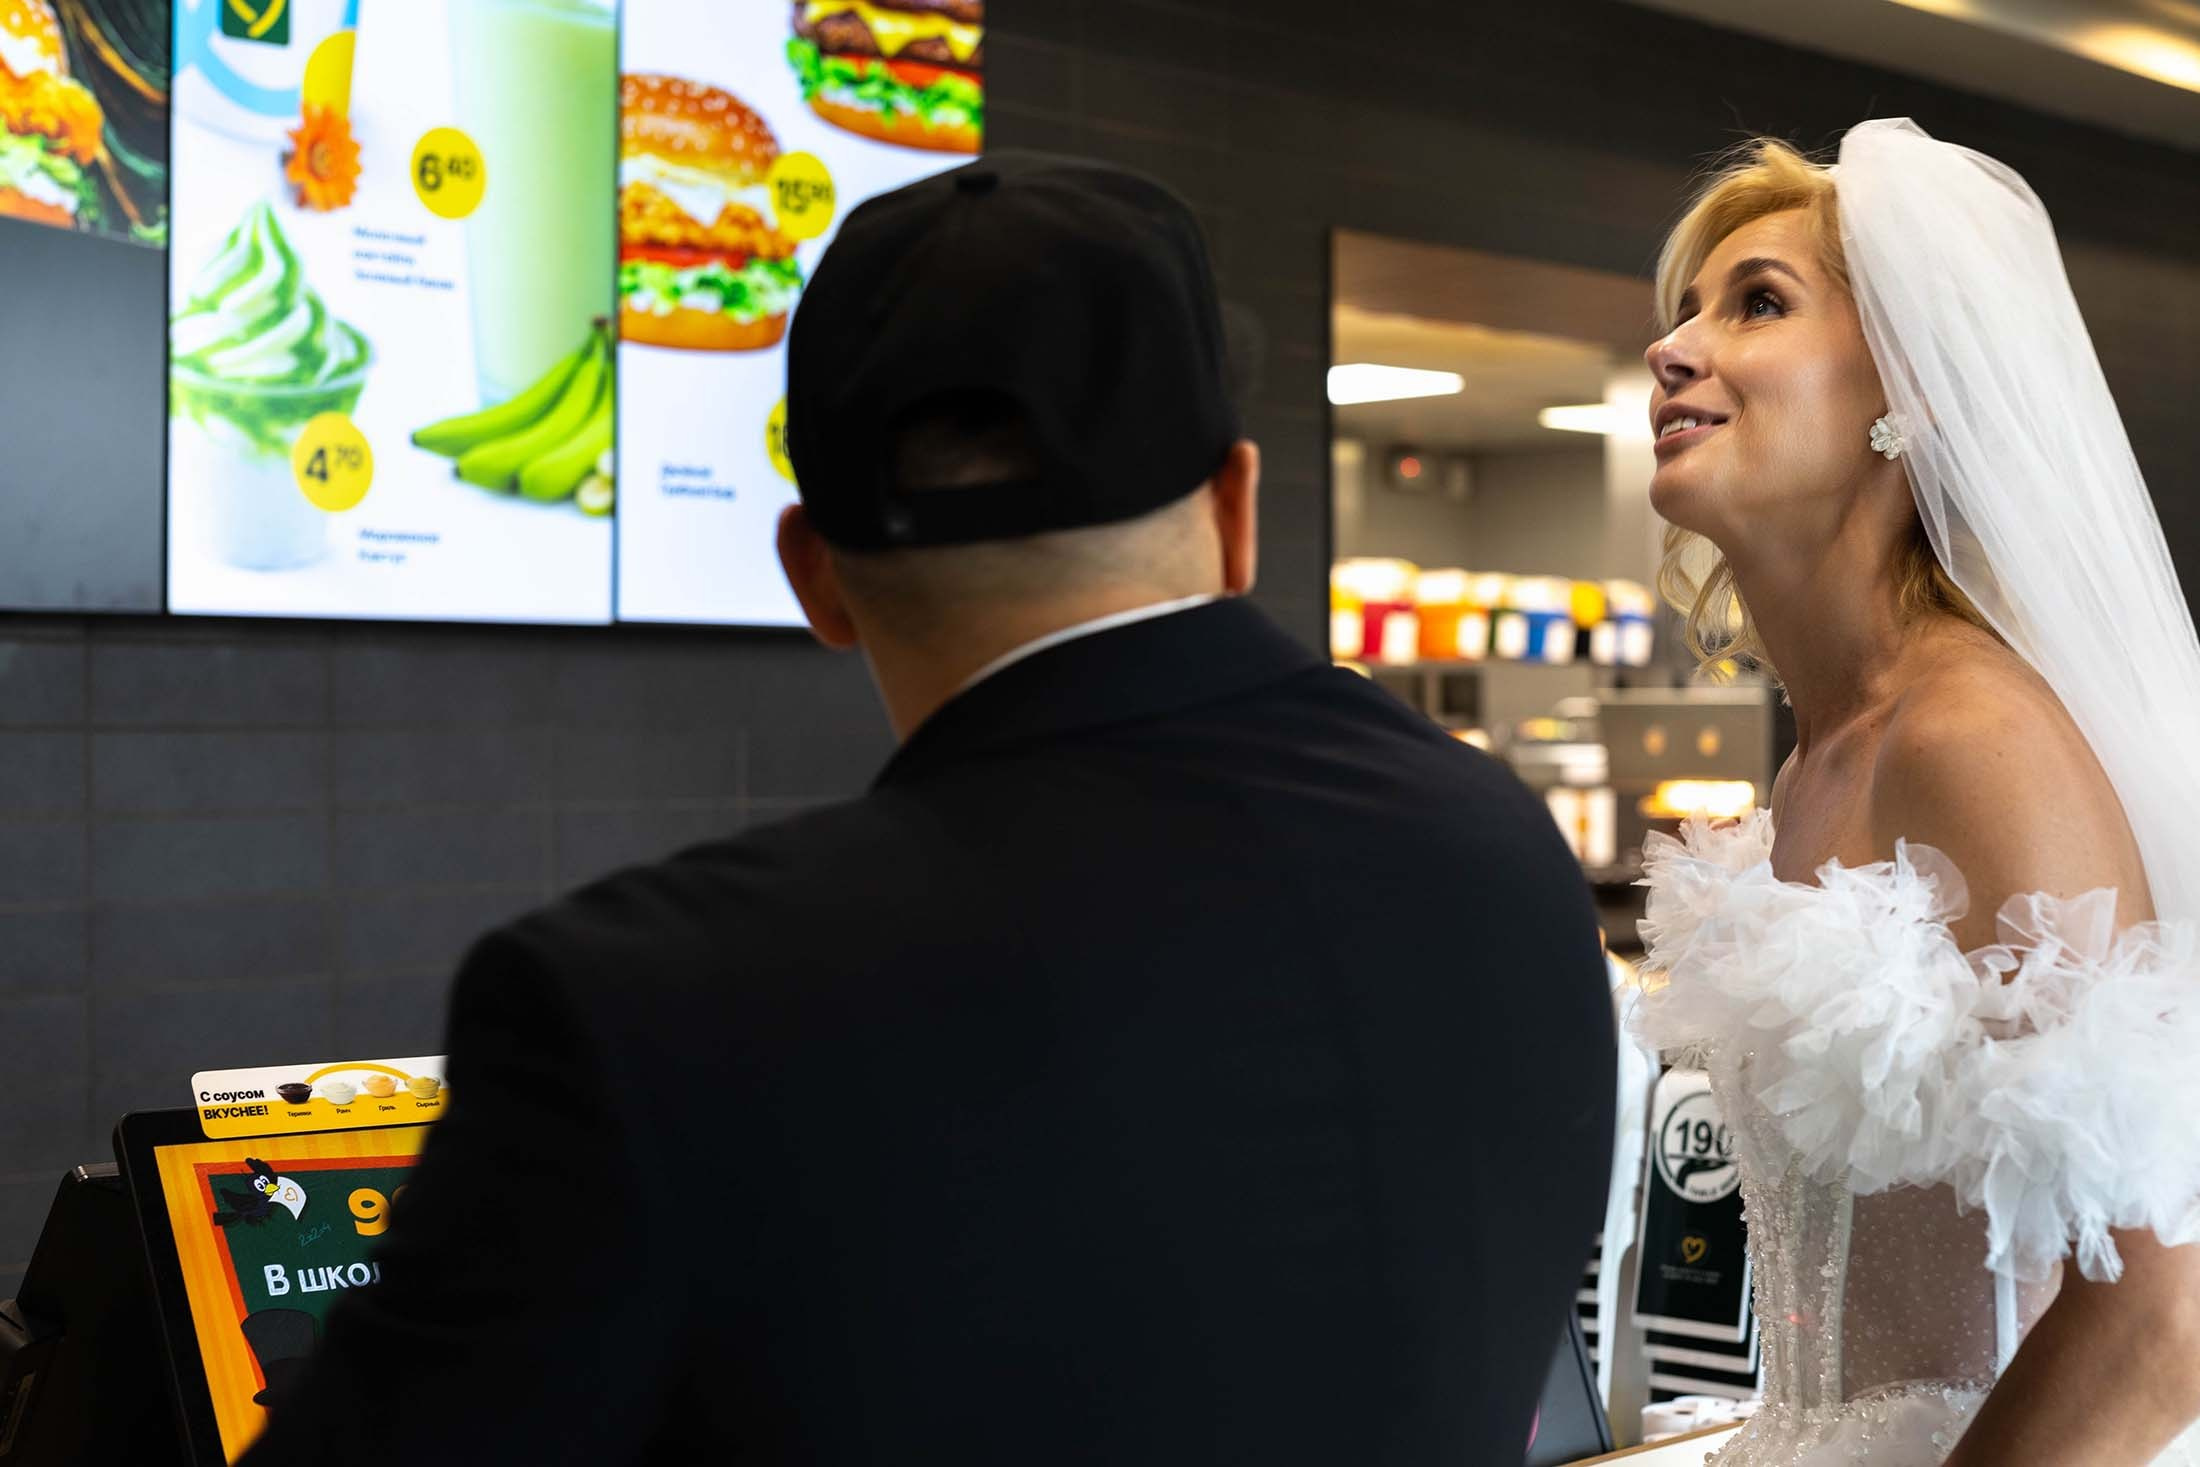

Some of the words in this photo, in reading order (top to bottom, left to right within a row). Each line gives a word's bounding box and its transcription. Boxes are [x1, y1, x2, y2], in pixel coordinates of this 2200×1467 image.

[199, 1090, 211, 1103] С
[213, 1089, 265, 1103] соусом
[202, 1104, 269, 1120] ВКУСНЕЕ!
[348, 1185, 408, 1237] 9
[263, 1264, 291, 1297] В
